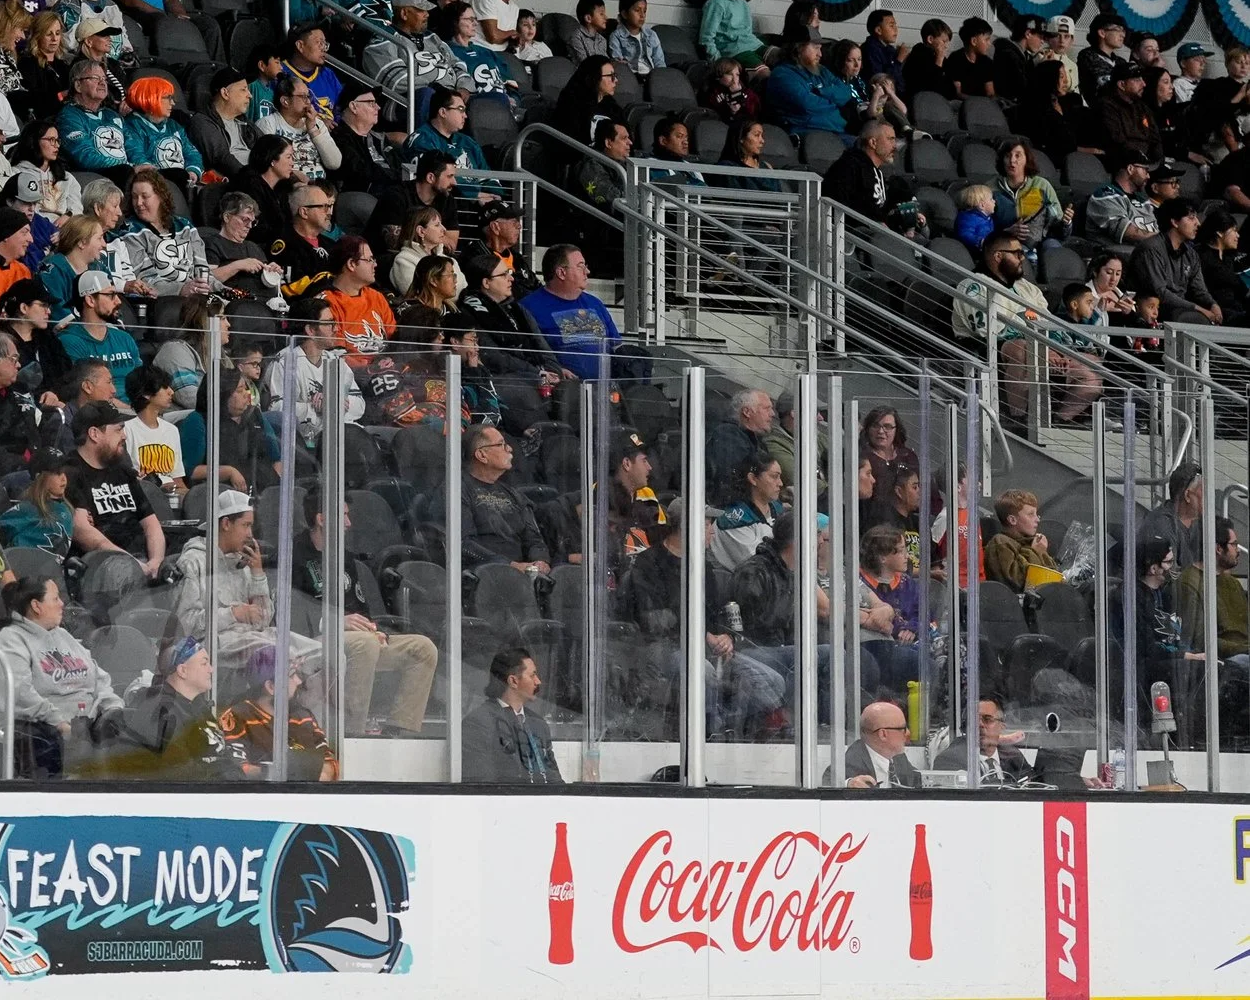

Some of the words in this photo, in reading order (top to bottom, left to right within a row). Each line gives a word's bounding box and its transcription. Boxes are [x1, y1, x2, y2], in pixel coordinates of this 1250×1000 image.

[371, 374, 400, 396] 25
[7, 839, 142, 909] FEAST
[154, 845, 265, 906] MODE
[611, 829, 870, 954] Coca-Cola
[1056, 815, 1077, 983] CCM
[87, 940, 204, 962] SJBARRACUDA.COM
